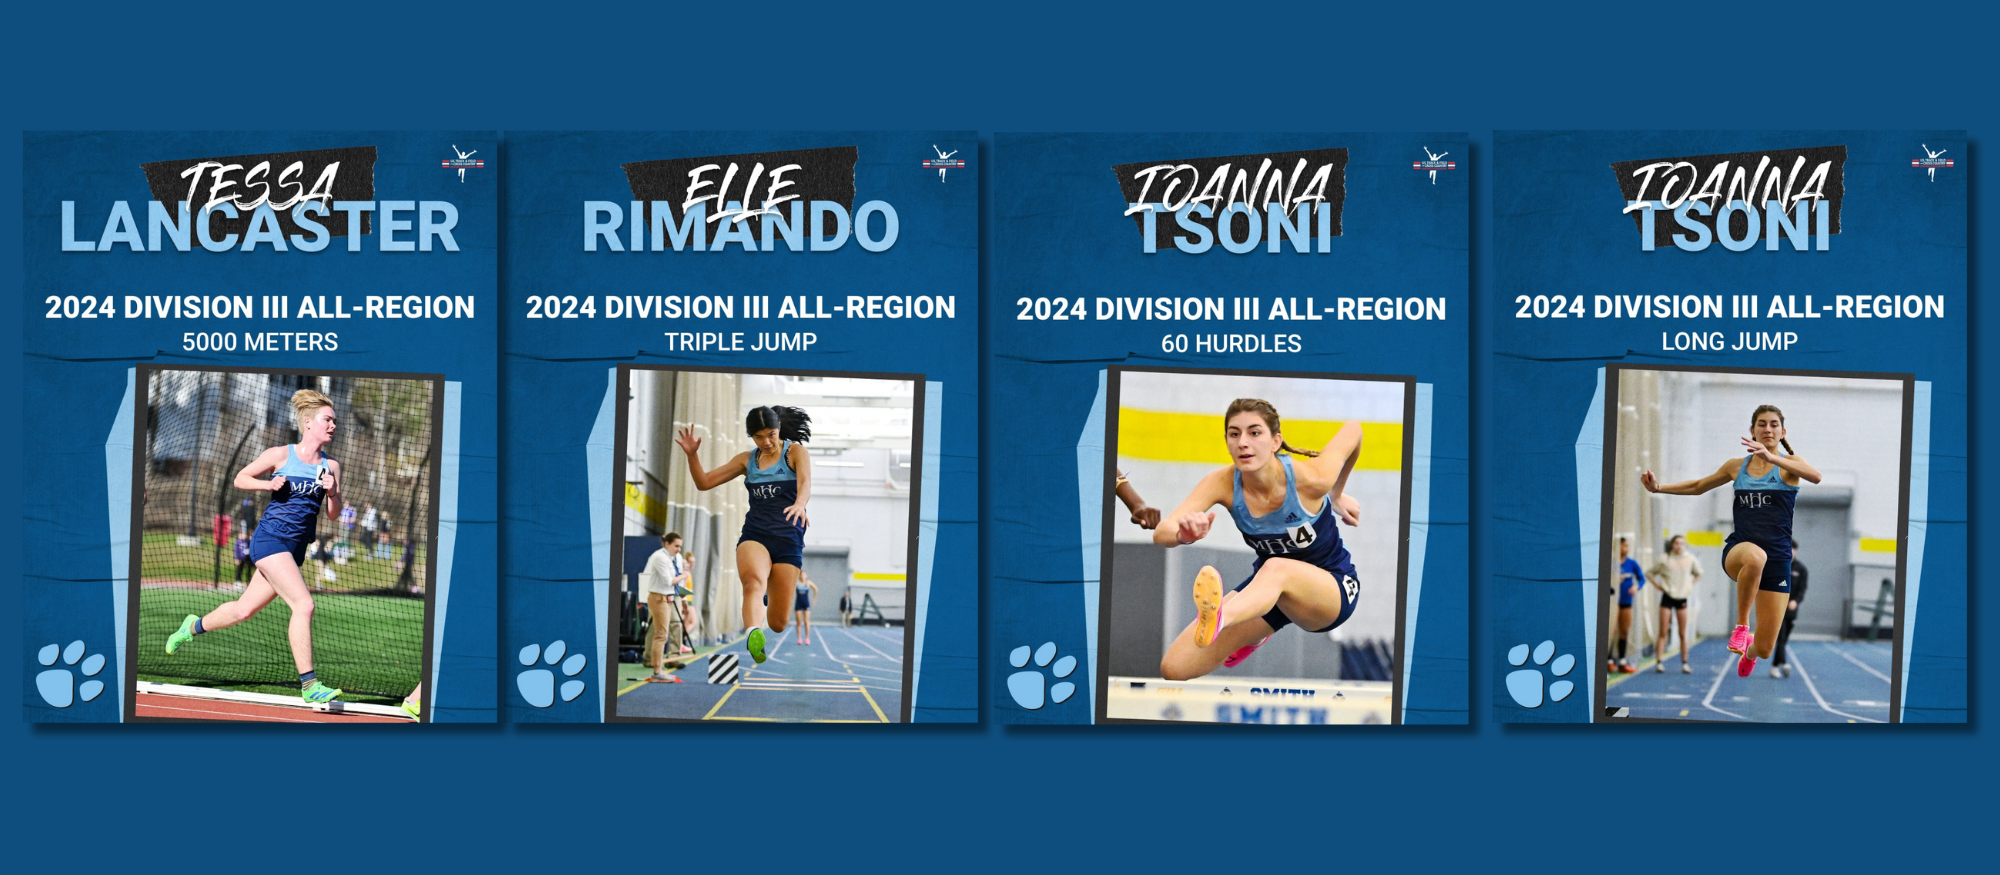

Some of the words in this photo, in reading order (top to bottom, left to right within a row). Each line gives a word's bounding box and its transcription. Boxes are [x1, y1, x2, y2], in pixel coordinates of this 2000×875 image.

[180, 160, 340, 217] TESSA
[682, 162, 802, 223] ELLE
[1124, 158, 1334, 218] IOANNA
[1622, 155, 1832, 216] IOANNA
[61, 200, 460, 252] LANCASTER
[584, 200, 899, 252] RIMANDO
[1129, 202, 1331, 254] TSONI
[1628, 200, 1830, 252] TSONI
[45, 295, 116, 319] 2024
[124, 295, 253, 319] DIVISION
[263, 295, 288, 319] III
[297, 295, 475, 319] ALL-REGION
[526, 295, 597, 319] 2024
[605, 295, 734, 319] DIVISION
[744, 295, 769, 319] III
[778, 295, 955, 319] ALL-REGION
[1016, 297, 1087, 321] 2024
[1096, 297, 1224, 321] DIVISION
[1234, 297, 1259, 321] III
[1268, 297, 1446, 321] ALL-REGION
[1515, 294, 1586, 319] 2024
[1594, 294, 1723, 319] DIVISION
[1733, 294, 1758, 318] III
[1767, 294, 1944, 319] ALL-REGION
[182, 332, 237, 351] 5000
[245, 332, 338, 351] METERS
[664, 332, 745, 351] TRIPLE
[750, 332, 817, 351] JUMP
[1161, 333, 1188, 353] 60
[1196, 333, 1302, 353] HURDLES
[1662, 332, 1725, 351] LONG
[1731, 332, 1798, 351] JUMP
[290, 480, 323, 495] MHC
[752, 484, 782, 499] MHC
[1739, 492, 1772, 508] MHC
[1295, 525, 1313, 544] 4
